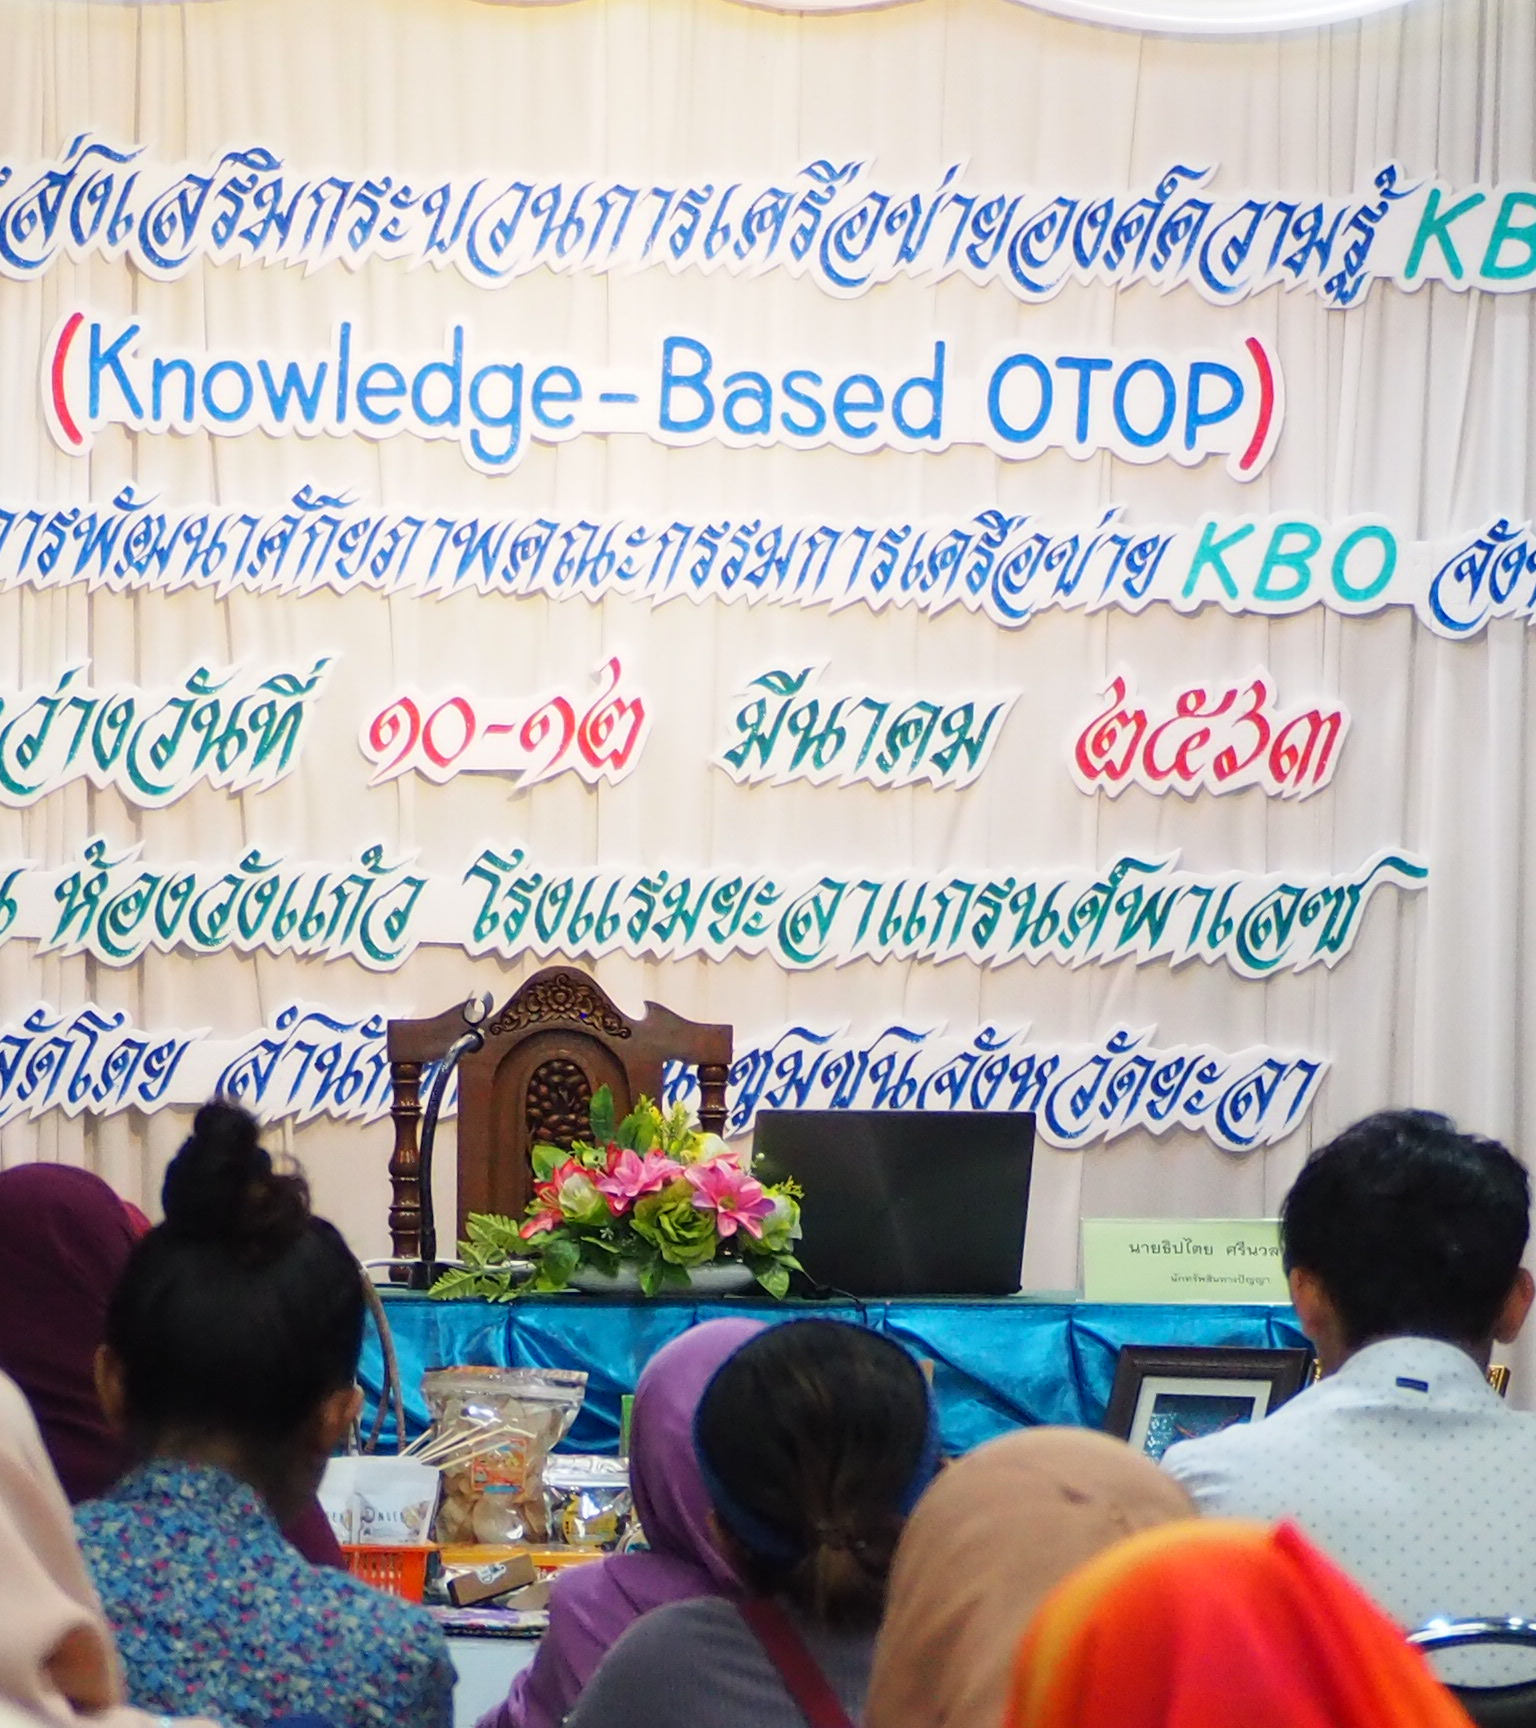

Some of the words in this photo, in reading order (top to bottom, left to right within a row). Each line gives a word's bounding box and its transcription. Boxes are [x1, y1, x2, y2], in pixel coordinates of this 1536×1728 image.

[987, 336, 1276, 471] OTOP)
[1180, 521, 1398, 603] KBO
[368, 656, 643, 780] ๑๐-๑๒
[725, 667, 1005, 776] มีนาคม
[53, 839, 429, 962] ห้องวังแก้ว
